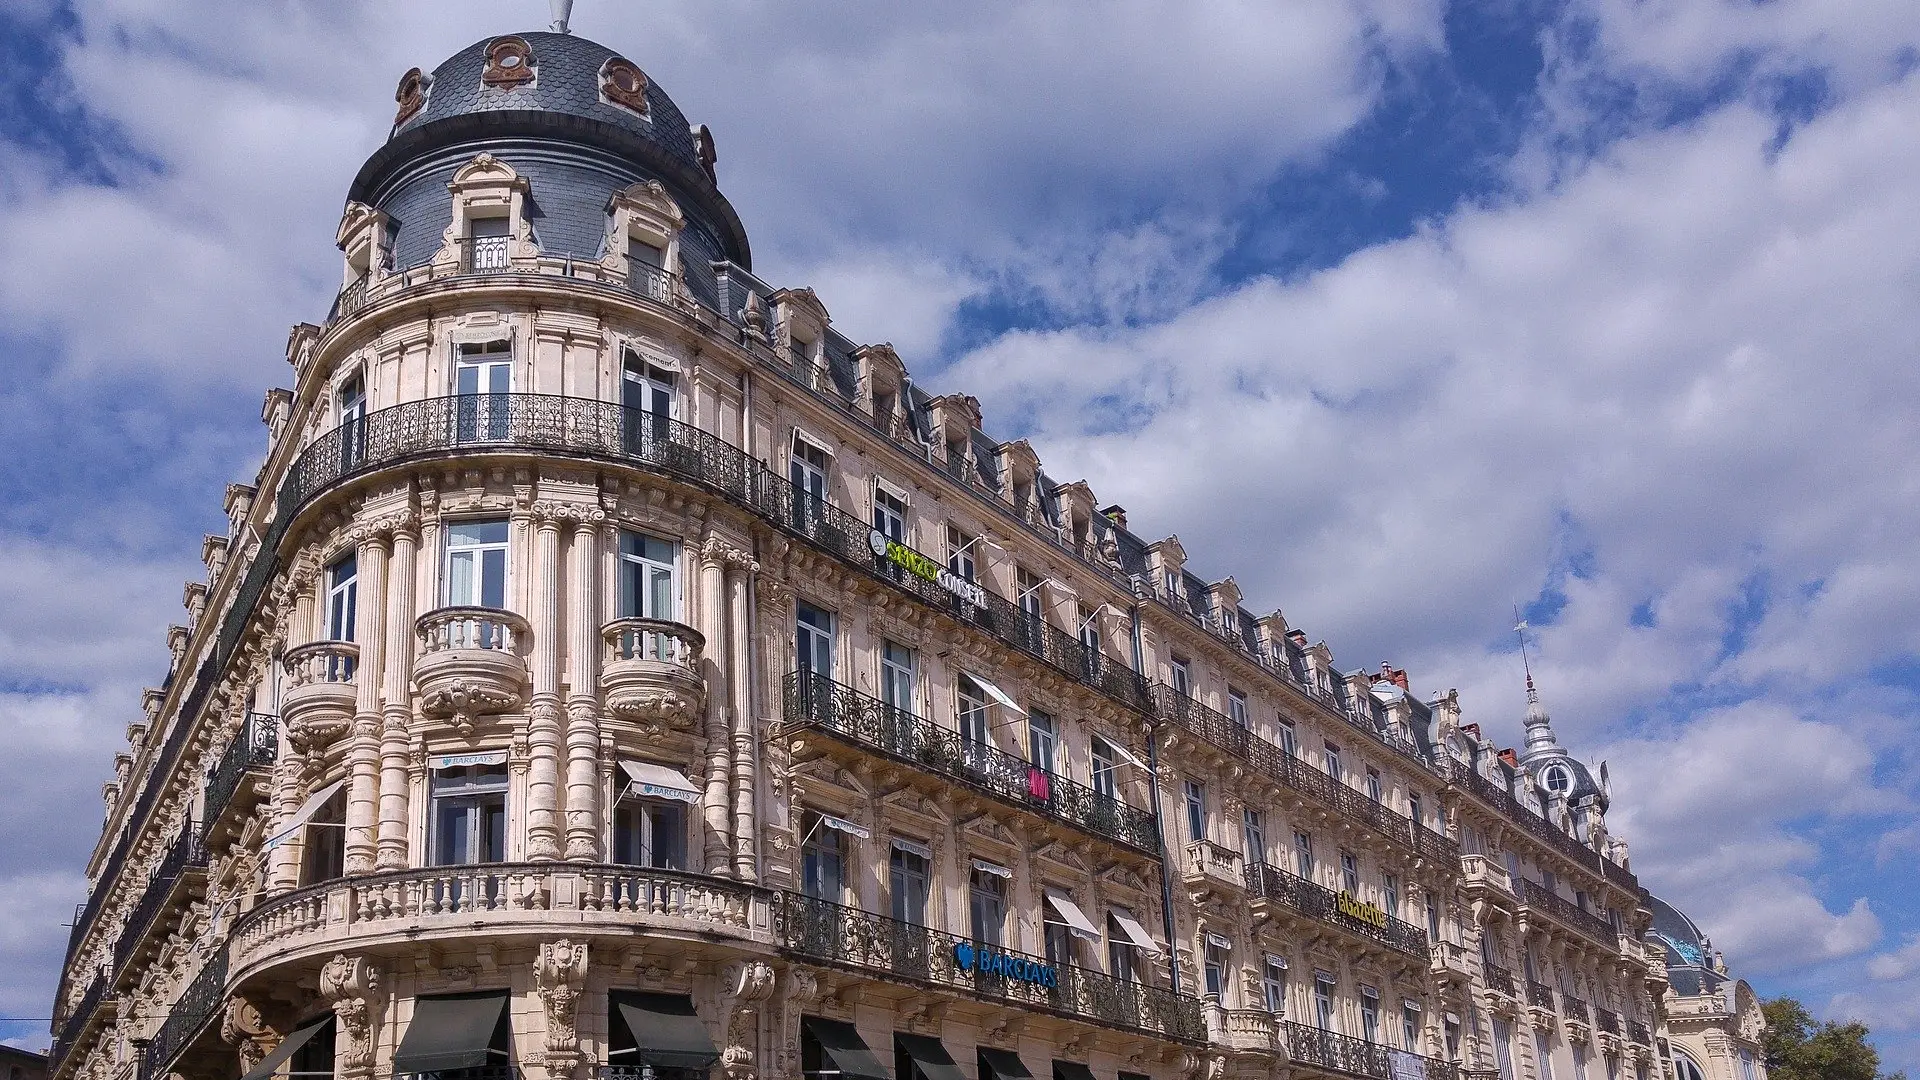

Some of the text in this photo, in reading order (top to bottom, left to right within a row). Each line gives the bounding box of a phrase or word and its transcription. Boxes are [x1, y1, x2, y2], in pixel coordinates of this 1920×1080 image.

[887, 541, 936, 581] SENZO
[936, 568, 988, 610] CONSEIL
[453, 756, 493, 764] BARCLAYS
[654, 787, 691, 799] BARCLAYS
[979, 950, 1056, 988] BARCLAYS
